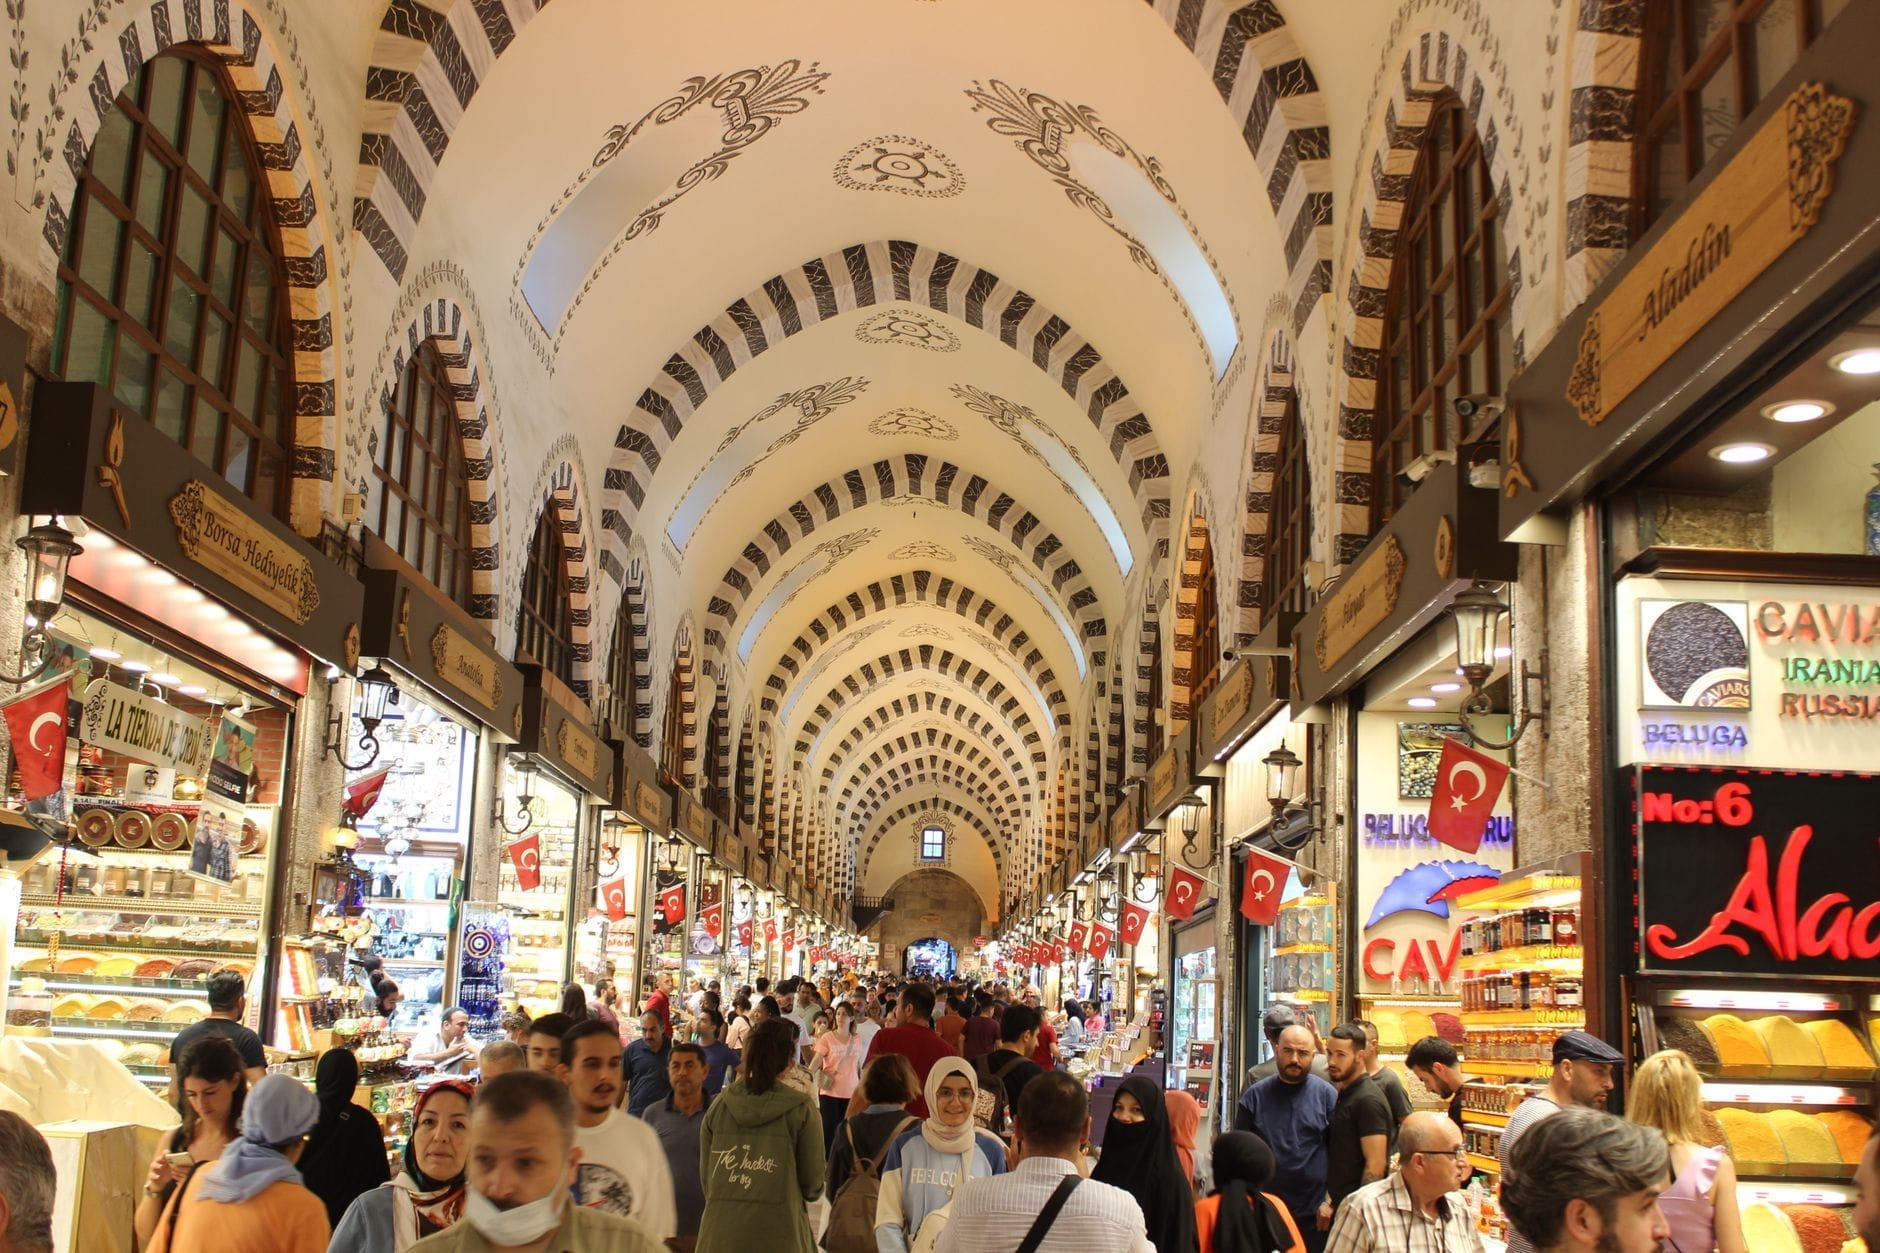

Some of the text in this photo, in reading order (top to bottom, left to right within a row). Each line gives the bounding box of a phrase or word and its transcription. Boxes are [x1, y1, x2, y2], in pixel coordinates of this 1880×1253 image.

[1639, 222, 1731, 342] Aladdin
[203, 511, 299, 595] Borsa Hediyelik
[1699, 682, 1749, 707] CAVIARS
[104, 699, 124, 740] LA
[162, 719, 179, 758] DE
[1643, 723, 1748, 746] BELUGA
[1642, 782, 1753, 826] No:6
[1364, 813, 1512, 842] BELUG RU
[712, 1145, 738, 1178] The
[910, 1168, 975, 1188] FEEL GO
